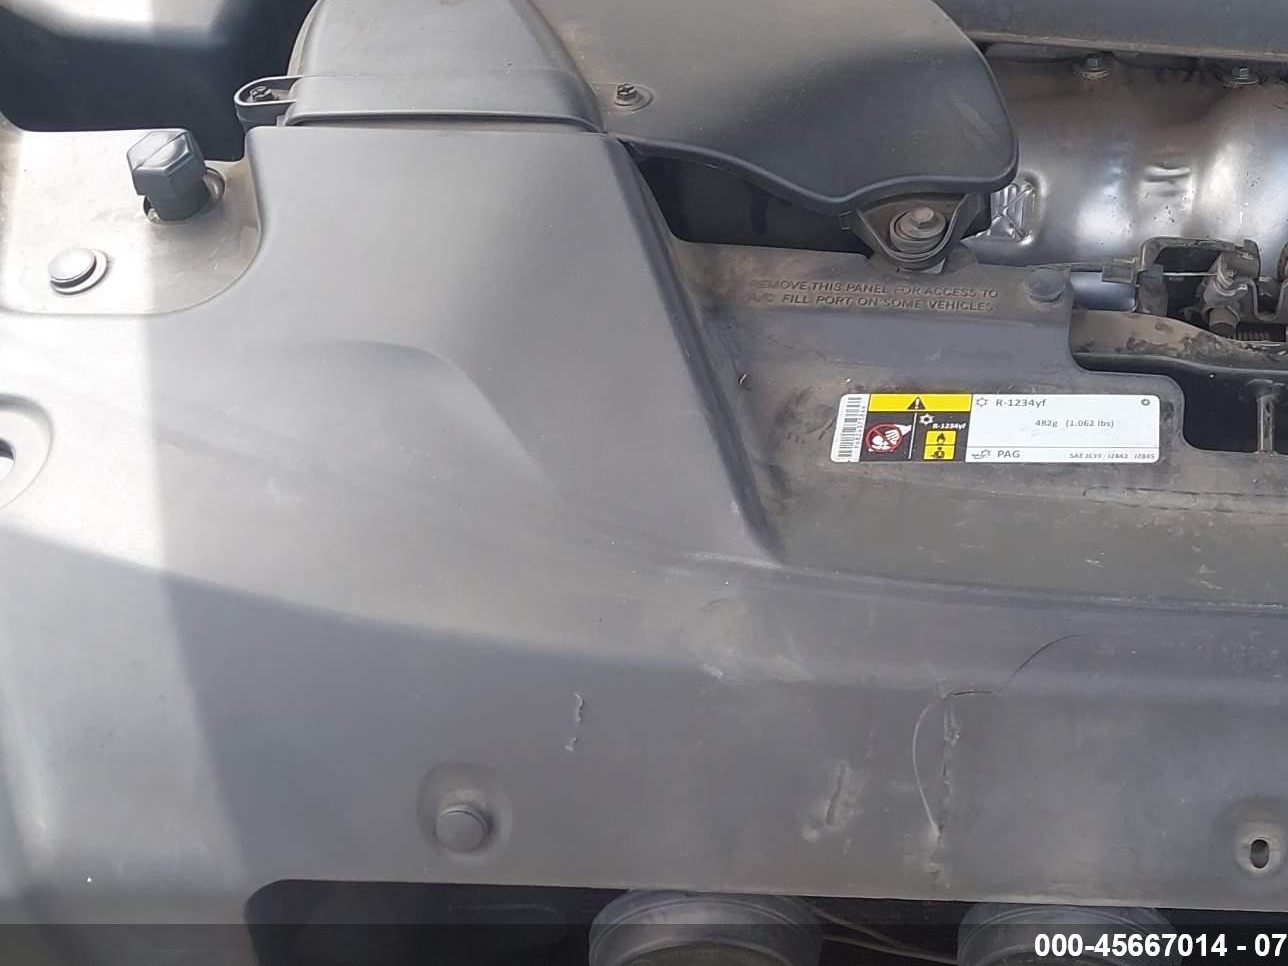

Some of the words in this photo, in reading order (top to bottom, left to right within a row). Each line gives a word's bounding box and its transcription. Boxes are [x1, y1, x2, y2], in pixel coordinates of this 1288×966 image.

[811, 281, 843, 292] THIS
[846, 283, 888, 294] PANEL
[894, 285, 922, 296] FOR
[924, 286, 977, 298] ACCESS
[982, 288, 999, 299] TO
[782, 293, 810, 305] FILL
[816, 294, 852, 306] PORT
[857, 296, 879, 307] ON
[883, 297, 923, 309] SOME
[927, 298, 994, 311] VEHICLES
[995, 398, 1047, 409] R-1234yf
[1034, 419, 1059, 429] 482g
[1065, 419, 1095, 428] (1.062
[1097, 419, 1114, 428] lbs)
[997, 450, 1021, 459] PAG
